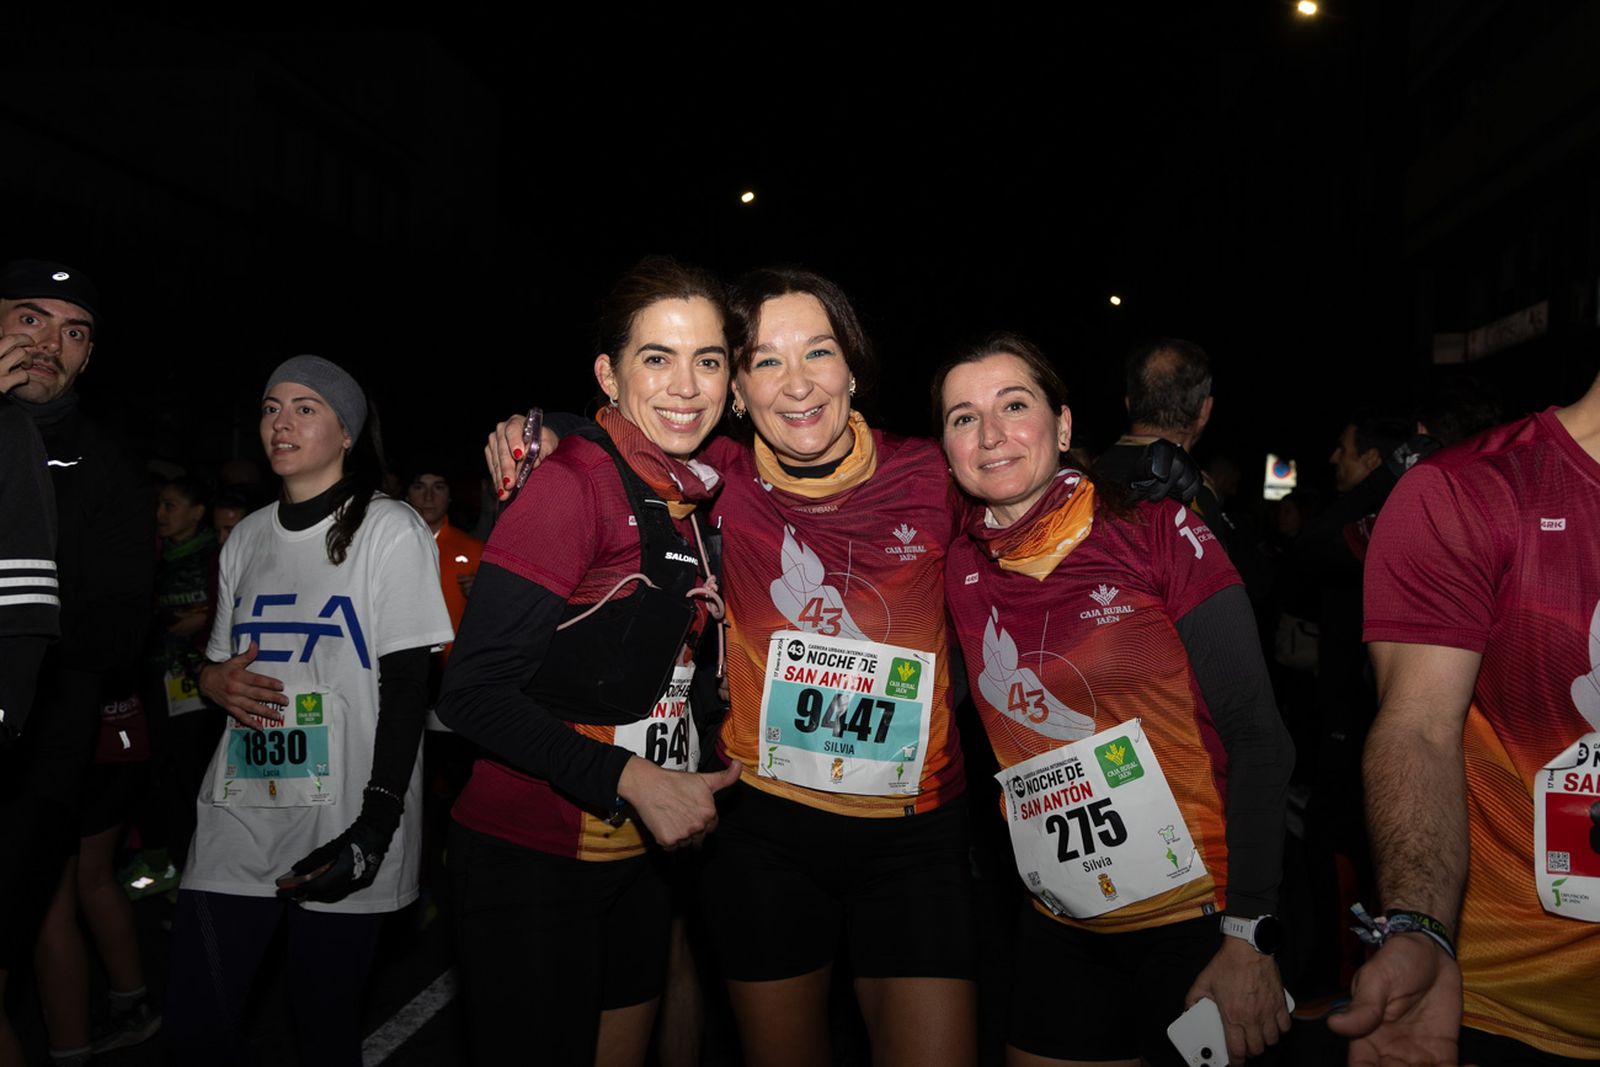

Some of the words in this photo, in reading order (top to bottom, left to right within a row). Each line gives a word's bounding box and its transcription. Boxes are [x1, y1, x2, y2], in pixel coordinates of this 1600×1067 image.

[904, 545, 927, 553] RURAL
[798, 597, 842, 636] 43
[1080, 608, 1102, 620] CAJA
[1103, 605, 1135, 616] RURAL
[788, 643, 804, 657] 43
[806, 650, 856, 670] NOCHE
[858, 658, 878, 674] DE
[784, 666, 818, 684] SAN
[794, 688, 896, 744] 9447
[1008, 682, 1050, 725] 43
[242, 730, 307, 766] 1830
[824, 740, 856, 755] SILVIA
[1026, 770, 1065, 796] NOCHE
[1064, 762, 1085, 781] DE
[1020, 798, 1042, 820] SAN
[1044, 781, 1094, 812] ANTÓN
[1045, 797, 1128, 864] 275
[1082, 855, 1112, 873] Silvia
